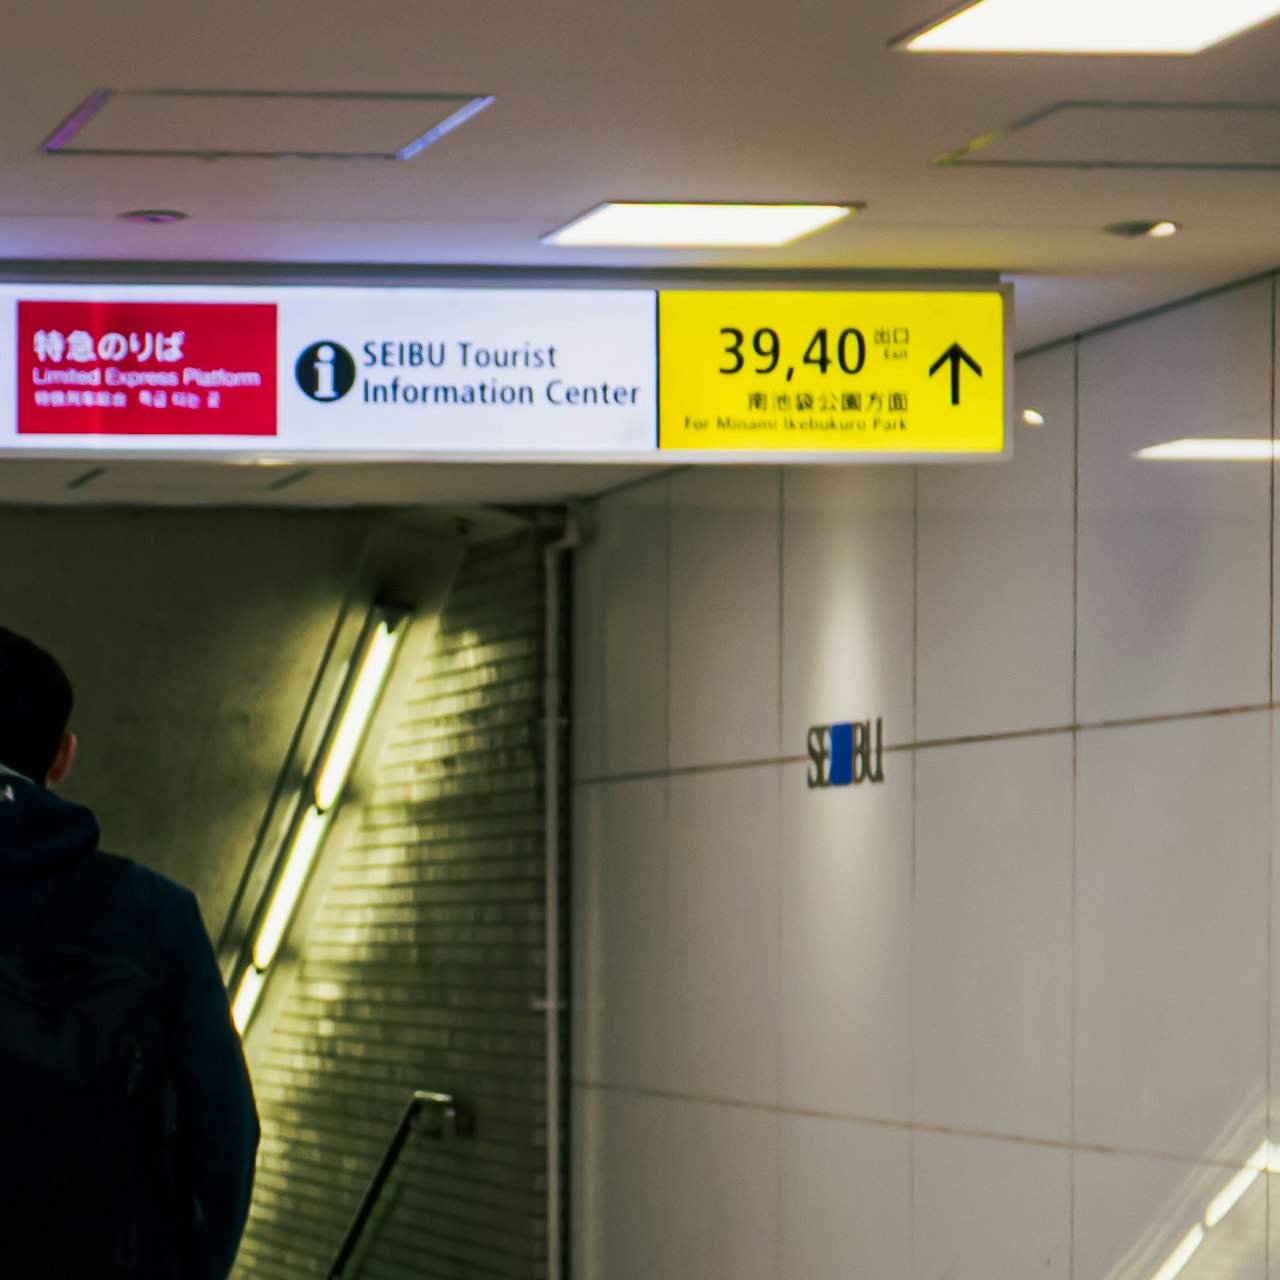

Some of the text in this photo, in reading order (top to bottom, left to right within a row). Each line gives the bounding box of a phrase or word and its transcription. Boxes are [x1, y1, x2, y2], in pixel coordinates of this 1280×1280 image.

[32, 329, 186, 363] 特急のりば
[363, 341, 557, 369] SEIBU Tourist
[718, 327, 909, 382] 39,40 出口
[883, 349, 908, 360] Exit
[32, 366, 261, 388] Limited Express Platform
[362, 376, 640, 406] Information Center
[748, 390, 909, 412] 南池袋公園方面
[684, 416, 908, 432] For Minami Ikebukuro Park
[806, 716, 885, 790] SEIBU
